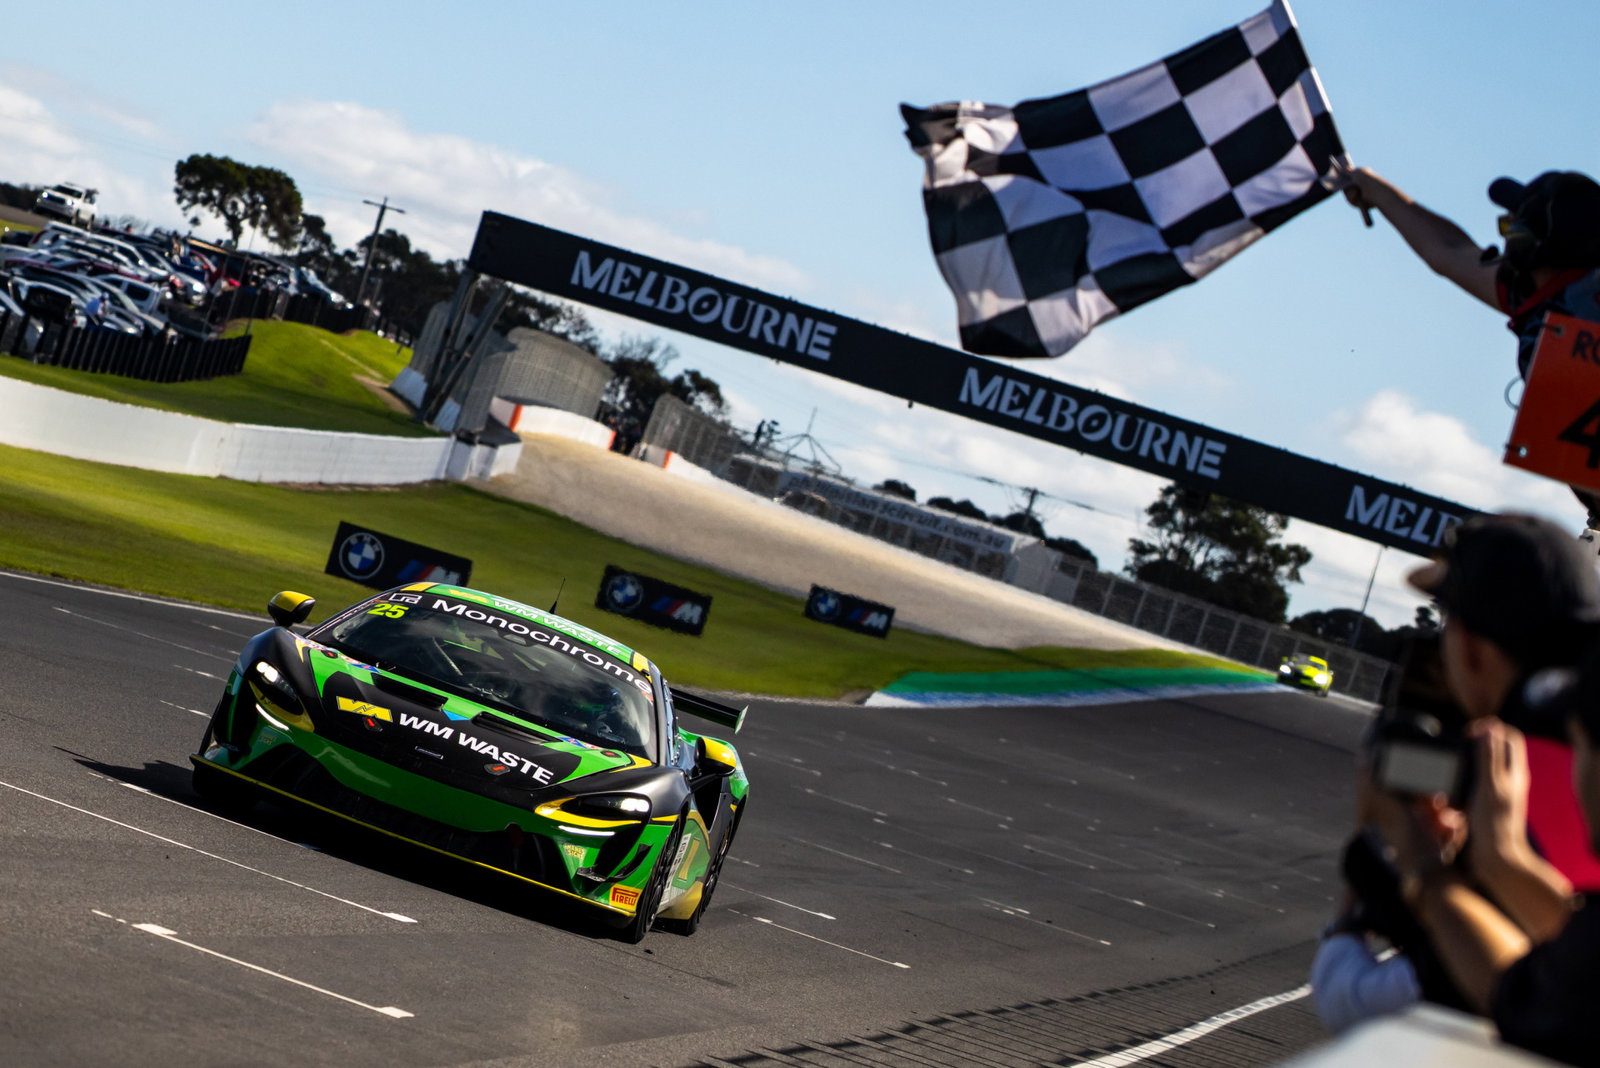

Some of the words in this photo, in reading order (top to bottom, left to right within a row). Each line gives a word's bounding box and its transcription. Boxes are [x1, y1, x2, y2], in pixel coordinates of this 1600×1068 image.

[570, 250, 838, 361] MELBOURNE
[958, 367, 1227, 479] MELBOURNE
[367, 603, 408, 620] 25
[432, 599, 652, 694] Monochrome
[544, 617, 622, 655] WASTE
[399, 713, 454, 740] WM
[458, 732, 554, 785] WASTE
